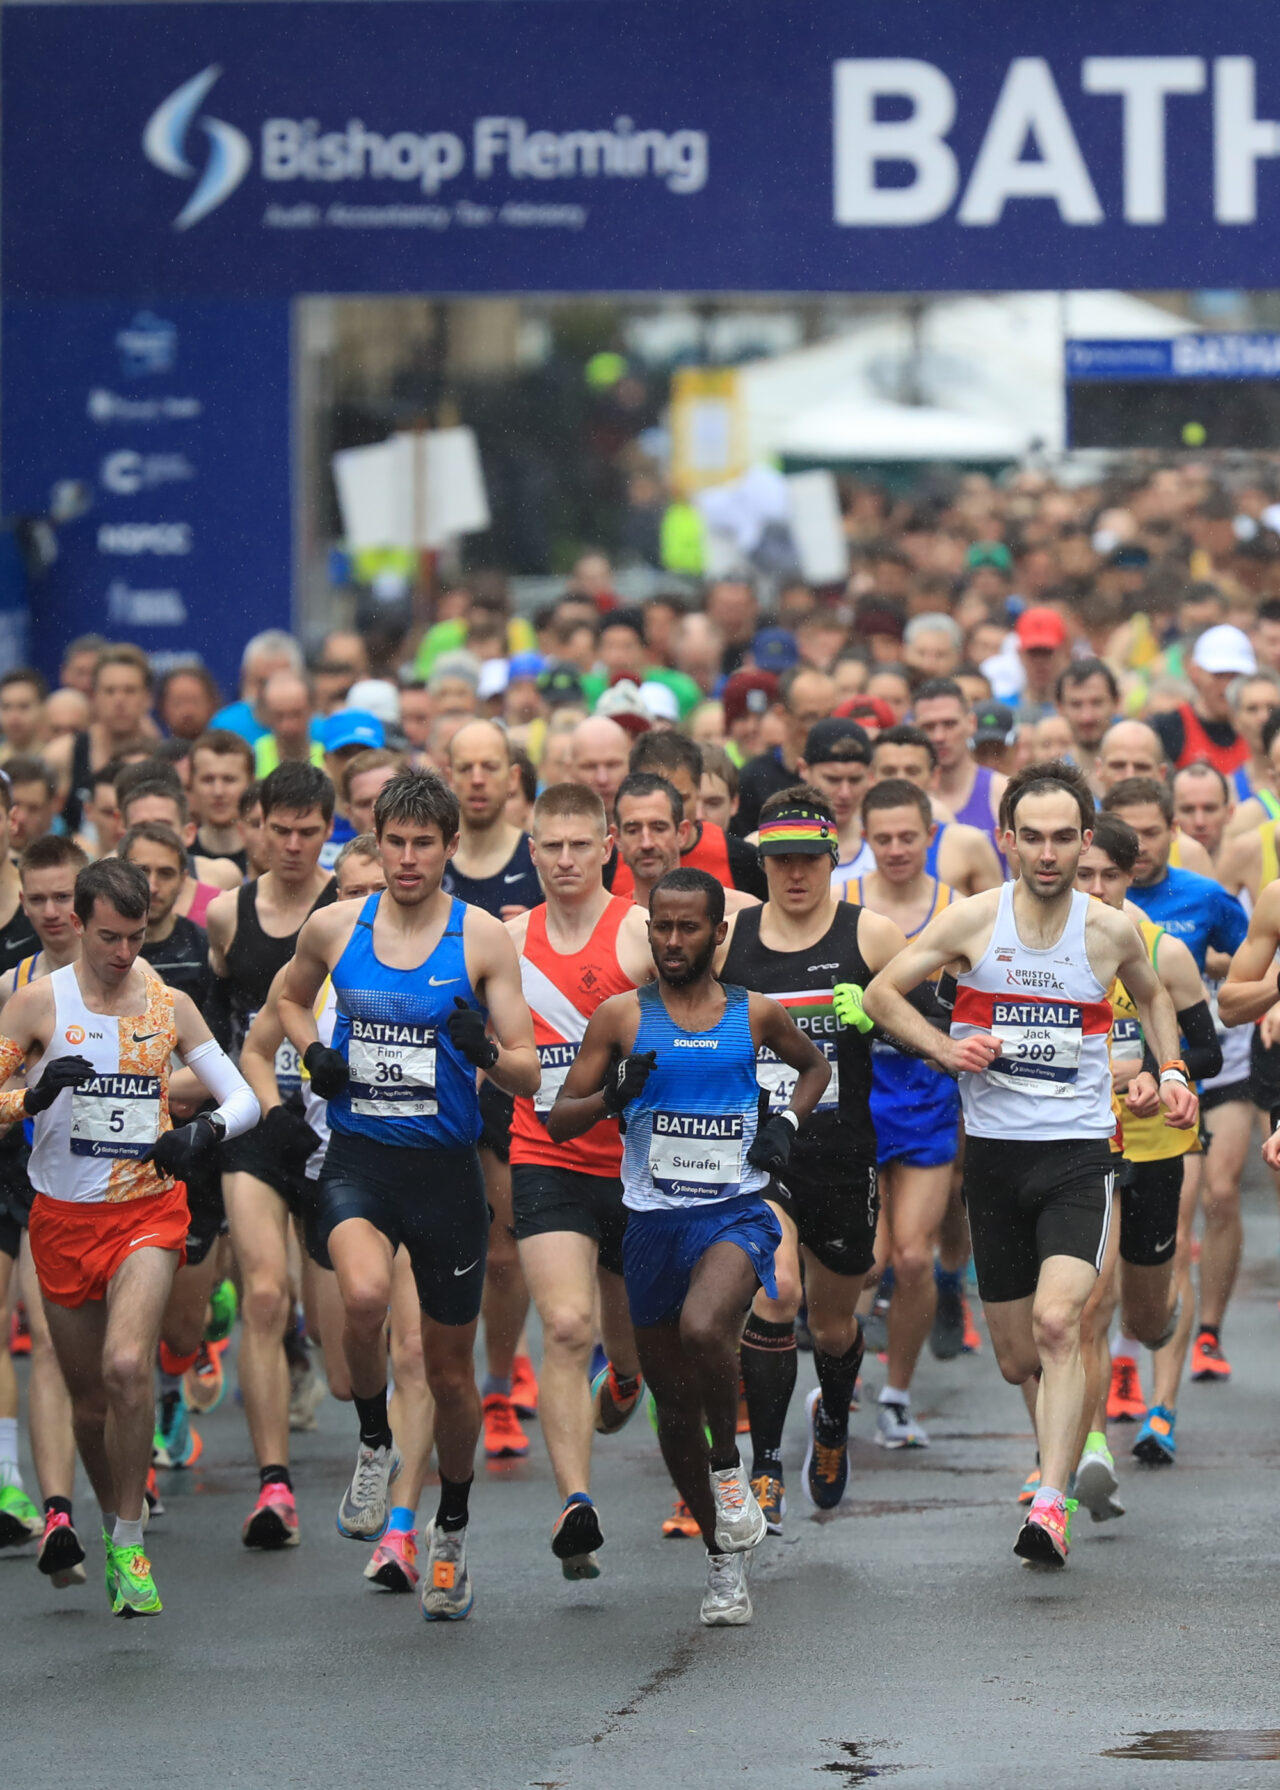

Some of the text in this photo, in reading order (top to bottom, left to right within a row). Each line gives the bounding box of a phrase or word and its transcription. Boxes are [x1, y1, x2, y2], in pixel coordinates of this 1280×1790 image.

[261, 115, 708, 194] Bishop Fleming
[1015, 969, 1056, 980] BRISTOL
[1022, 979, 1064, 990] WEST AC
[994, 1005, 1080, 1025] BATHALF
[89, 1032, 103, 1040] NN
[352, 1021, 435, 1044] BATHALF
[1023, 1029, 1051, 1039] Jack
[673, 1038, 719, 1050] saucony
[377, 1046, 403, 1058] Finn
[1016, 1043, 1056, 1062] 309
[375, 1062, 403, 1083] 30
[109, 1110, 124, 1133] 5
[656, 1114, 742, 1137] BATHALF
[72, 1124, 80, 1132] A
[101, 1146, 119, 1155] Bishop
[651, 1163, 660, 1172] A
[672, 1156, 721, 1171] Surafel
[681, 1185, 718, 1196] Bishop Fleming
